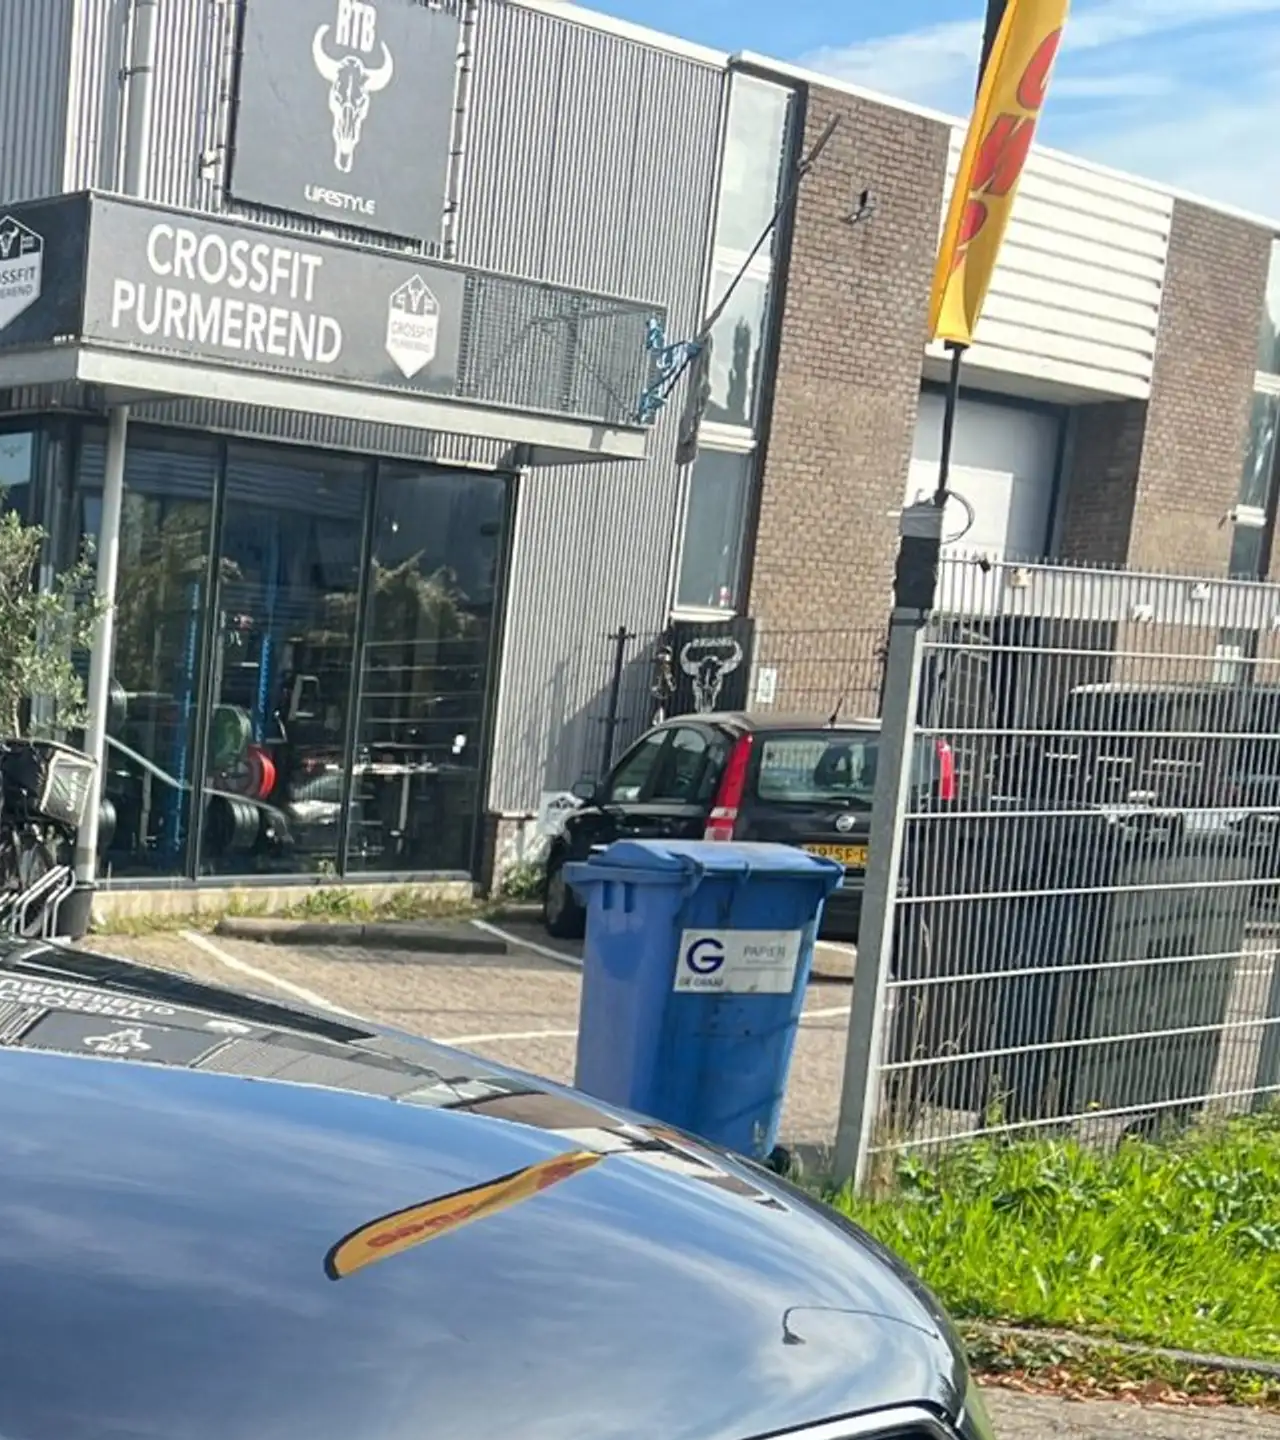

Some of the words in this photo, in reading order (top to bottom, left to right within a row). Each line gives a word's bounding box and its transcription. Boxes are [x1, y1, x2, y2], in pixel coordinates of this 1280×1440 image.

[336, 0, 377, 52] RTB
[304, 184, 376, 215] LIFESTYLE
[146, 223, 323, 301] CROSSFIT
[111, 278, 342, 364] PURMEREND
[686, 937, 725, 974] G
